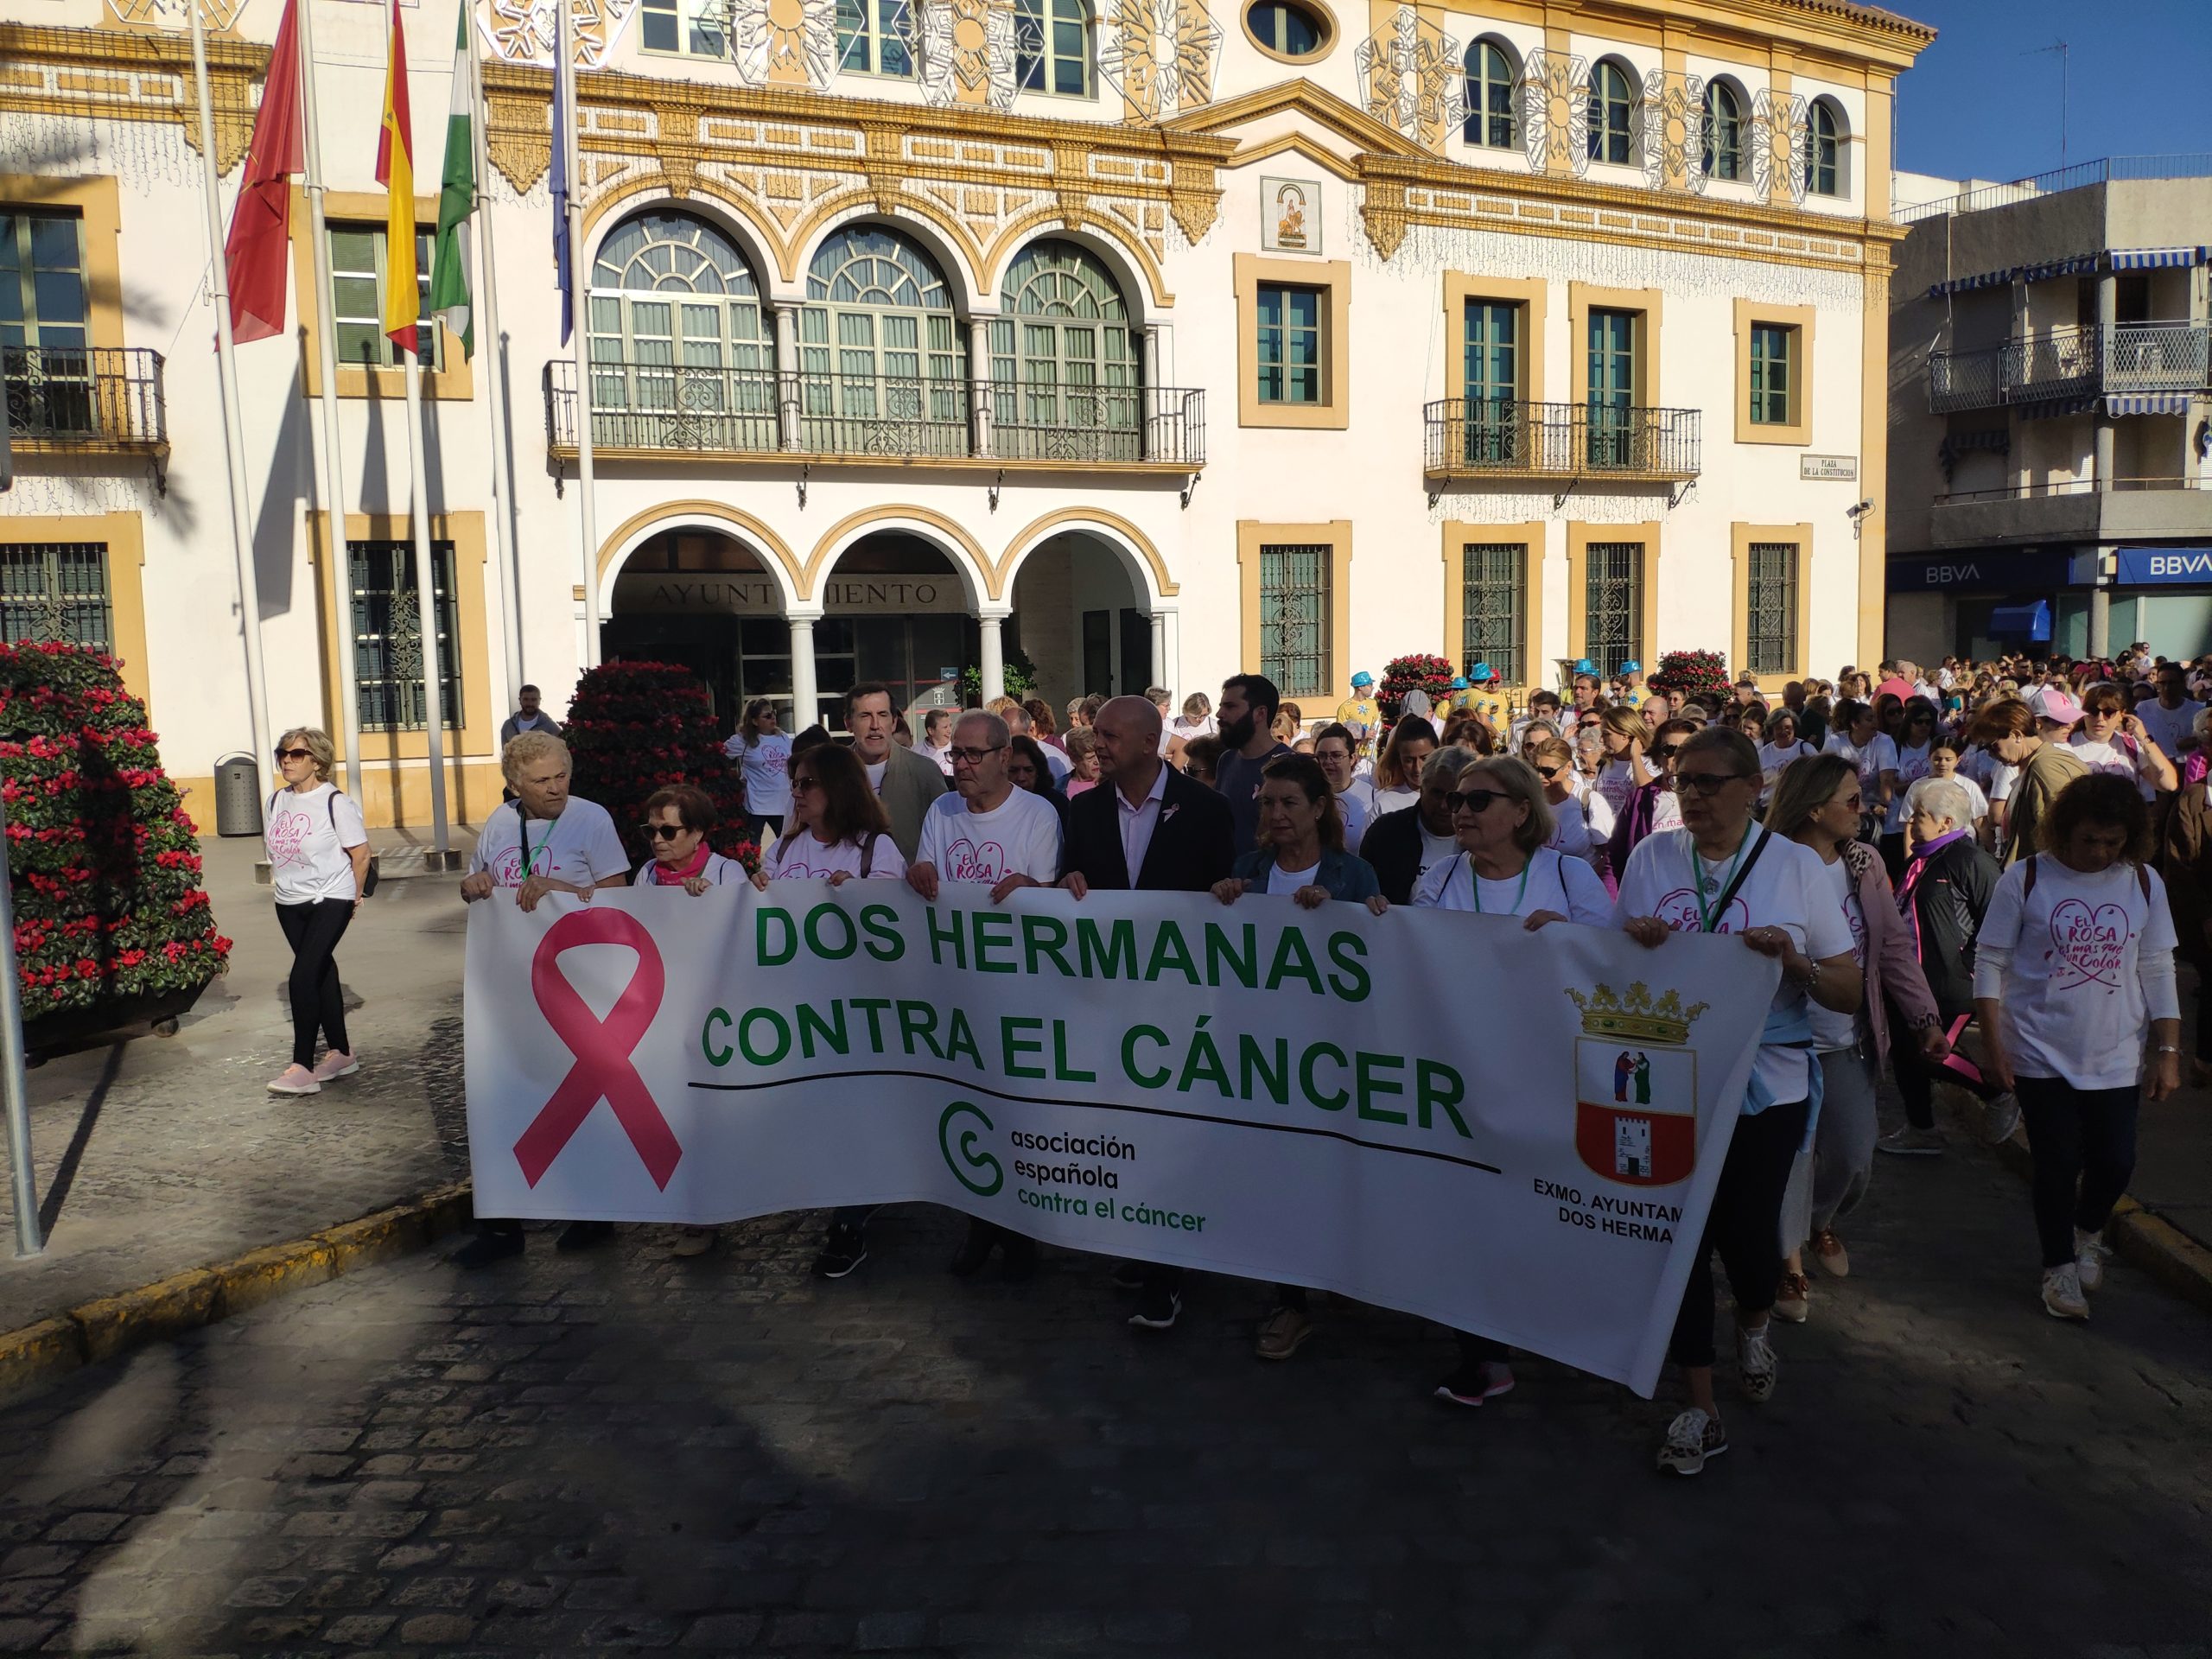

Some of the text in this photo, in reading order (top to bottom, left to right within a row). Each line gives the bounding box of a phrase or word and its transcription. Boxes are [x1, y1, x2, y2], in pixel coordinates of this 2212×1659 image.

[1821, 459, 1837, 467] PLAZA
[1926, 563, 1980, 583] BBVA
[2150, 552, 2212, 575] BBVA
[276, 827, 300, 838] ROSA
[956, 863, 992, 879] ROSA
[2075, 916, 2090, 927] EL
[2068, 925, 2117, 943] ROSA
[756, 902, 1371, 1002] DOS HERMANAS
[702, 998, 1474, 1140] CONTRA EL CÁNCER
[1011, 1129, 1135, 1160] asociación
[1014, 1159, 1118, 1189] española
[1534, 1178, 1586, 1207] EXMO.
[1018, 1188, 1206, 1232] contra el cáncer
[1559, 1206, 1597, 1230] DOS
